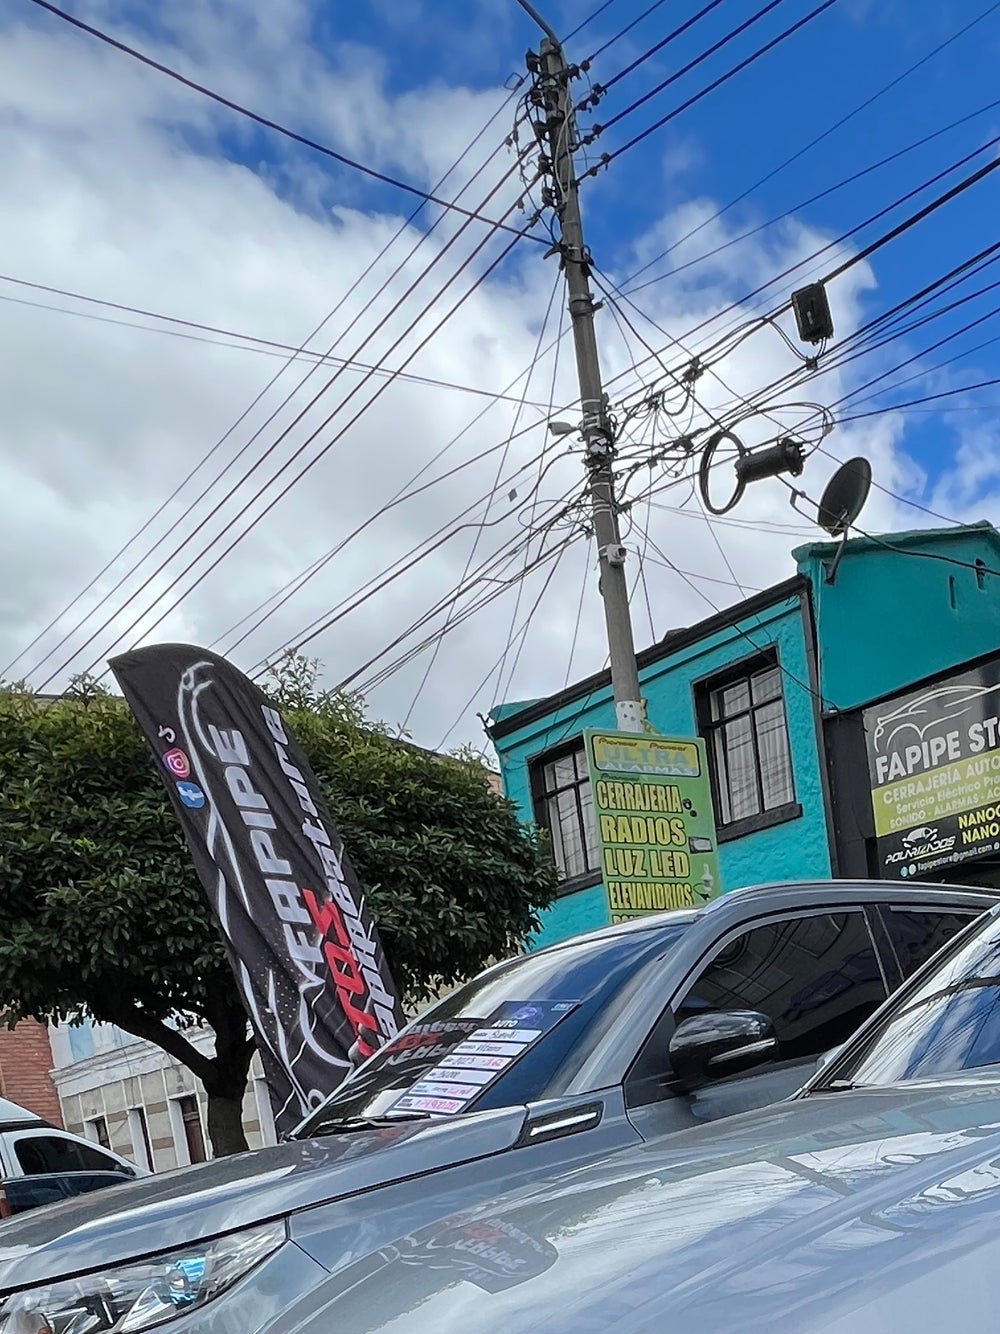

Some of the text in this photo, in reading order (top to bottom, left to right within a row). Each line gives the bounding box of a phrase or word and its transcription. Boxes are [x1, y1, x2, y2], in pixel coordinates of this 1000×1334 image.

[875, 731, 961, 784] FAPIPE
[596, 780, 683, 814] CERRAJERIA
[890, 812, 926, 829] SONIDO
[934, 793, 979, 816] ALARMAS
[896, 794, 935, 814] Servicio
[208, 724, 324, 964] FAPIPE
[599, 814, 687, 847] RADIOS
[603, 848, 690, 878] LUZ LED
[885, 835, 957, 865] POLARIZADOS
[608, 881, 694, 910] ELEVAVIDRIOS
[491, 1019, 519, 1028] AUTO
